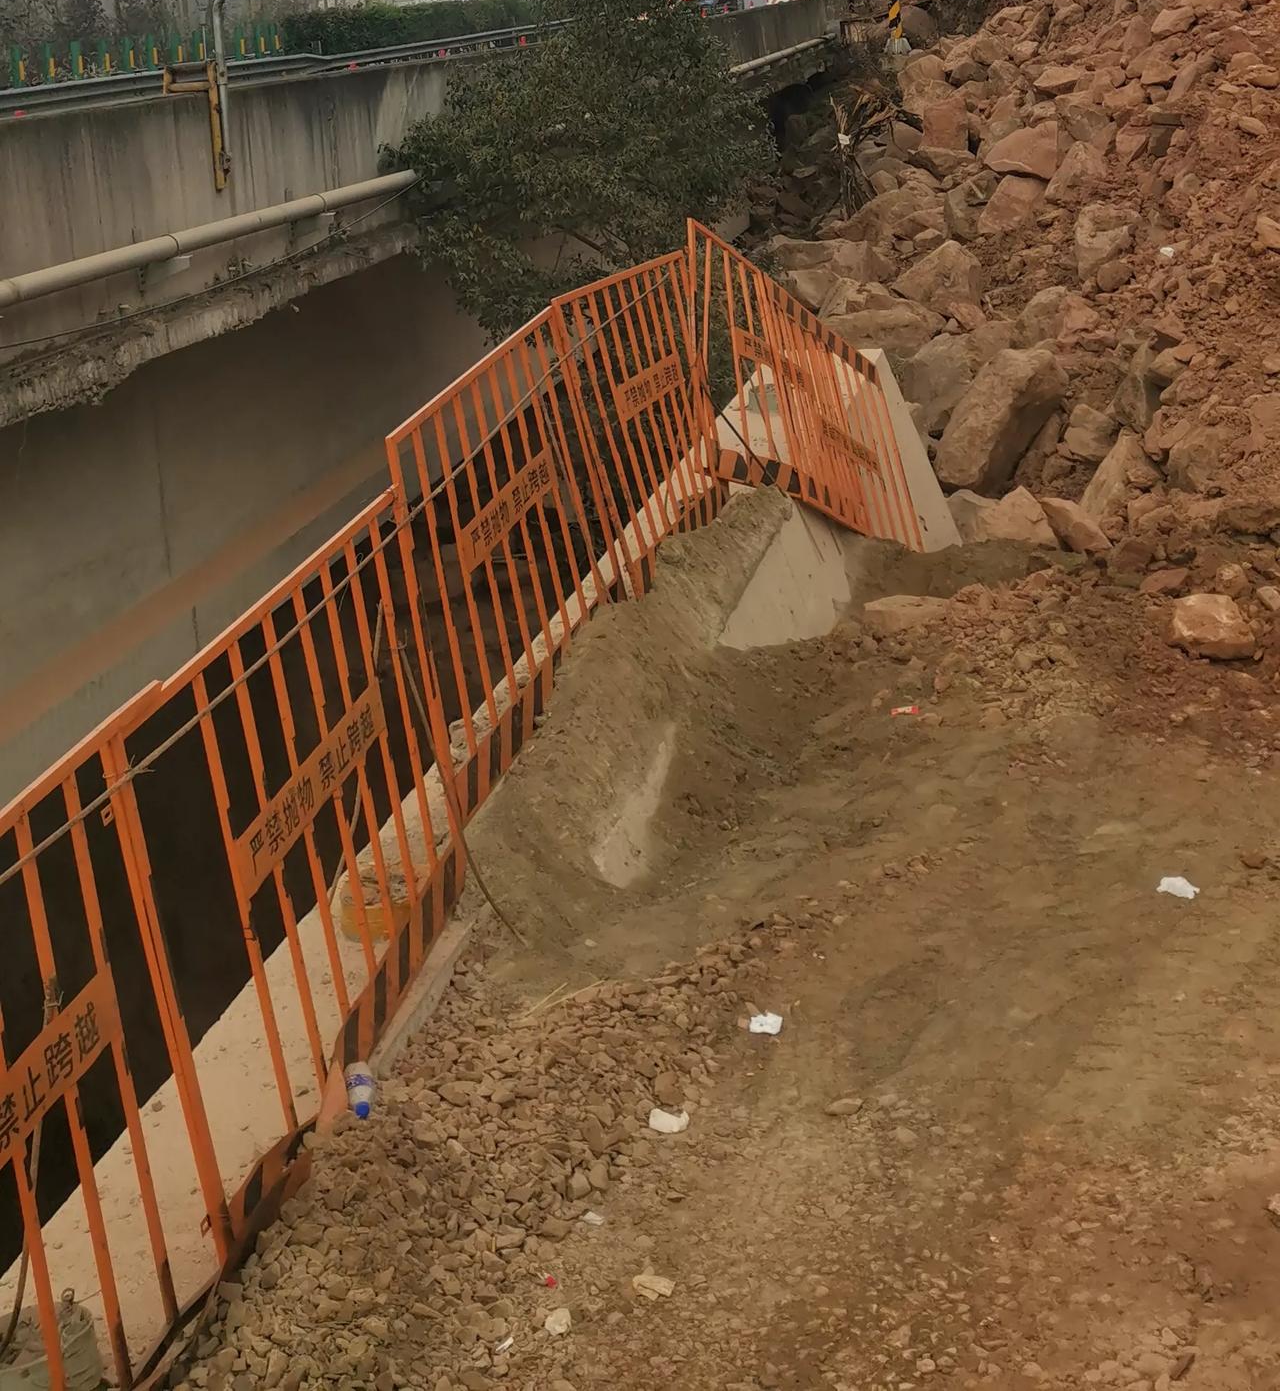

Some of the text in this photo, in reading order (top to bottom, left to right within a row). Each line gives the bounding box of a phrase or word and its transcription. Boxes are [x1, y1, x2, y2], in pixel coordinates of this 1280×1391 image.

[249, 703, 376, 876] 严禁抛物 禁止跨越
